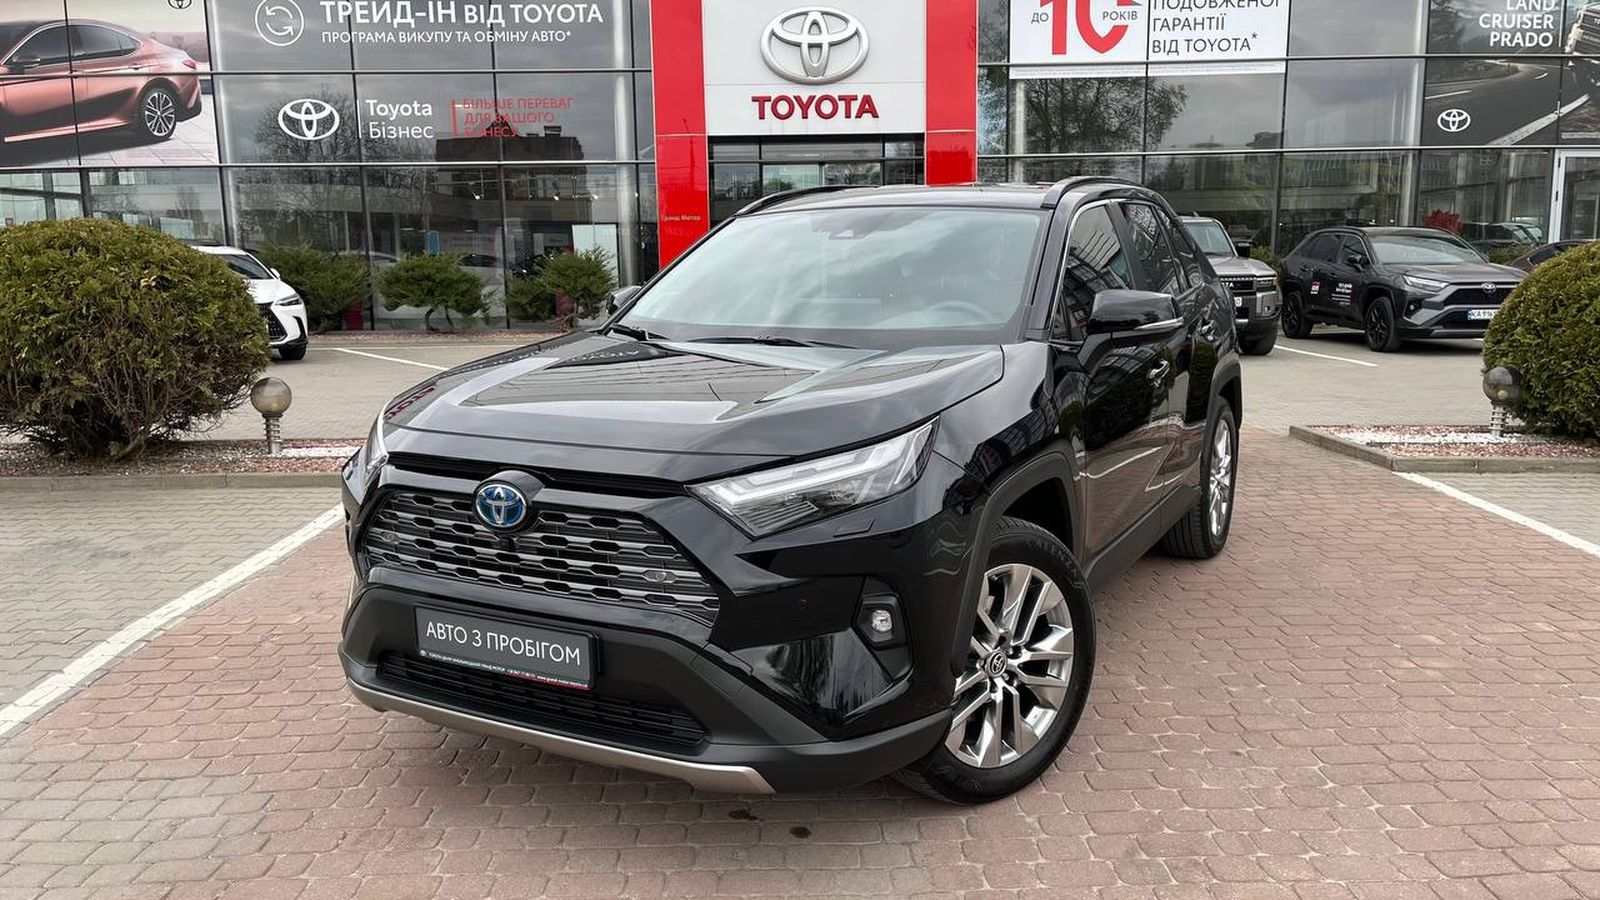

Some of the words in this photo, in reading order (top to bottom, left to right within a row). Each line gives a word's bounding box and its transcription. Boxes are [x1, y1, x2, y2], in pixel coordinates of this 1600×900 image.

[1506, 0, 1556, 11] LAND
[464, 4, 506, 28] ВІД
[509, 4, 604, 24] TOYOTA
[1031, 12, 1049, 24] ДО
[1102, 10, 1138, 21] РОКІВ
[1153, 13, 1227, 32] ГАРАНТІЇ
[1479, 13, 1554, 29] CRUISER
[322, 31, 396, 43] ПРОГРАМА
[399, 31, 452, 43] ВИКУПУ
[456, 31, 472, 42] ТА
[474, 30, 528, 42] ОБМІНУ
[1489, 31, 1553, 47] PRADO
[1152, 39, 1180, 56] ВІД
[366, 100, 433, 120] Toyota
[515, 98, 573, 109] ПЕРЕВАГ
[751, 94, 879, 120] TOYOTA
[369, 121, 434, 139] Бізнес
[426, 621, 468, 645] АВТО
[472, 629, 482, 647] З
[486, 632, 581, 666] ПРОБІГОМ
